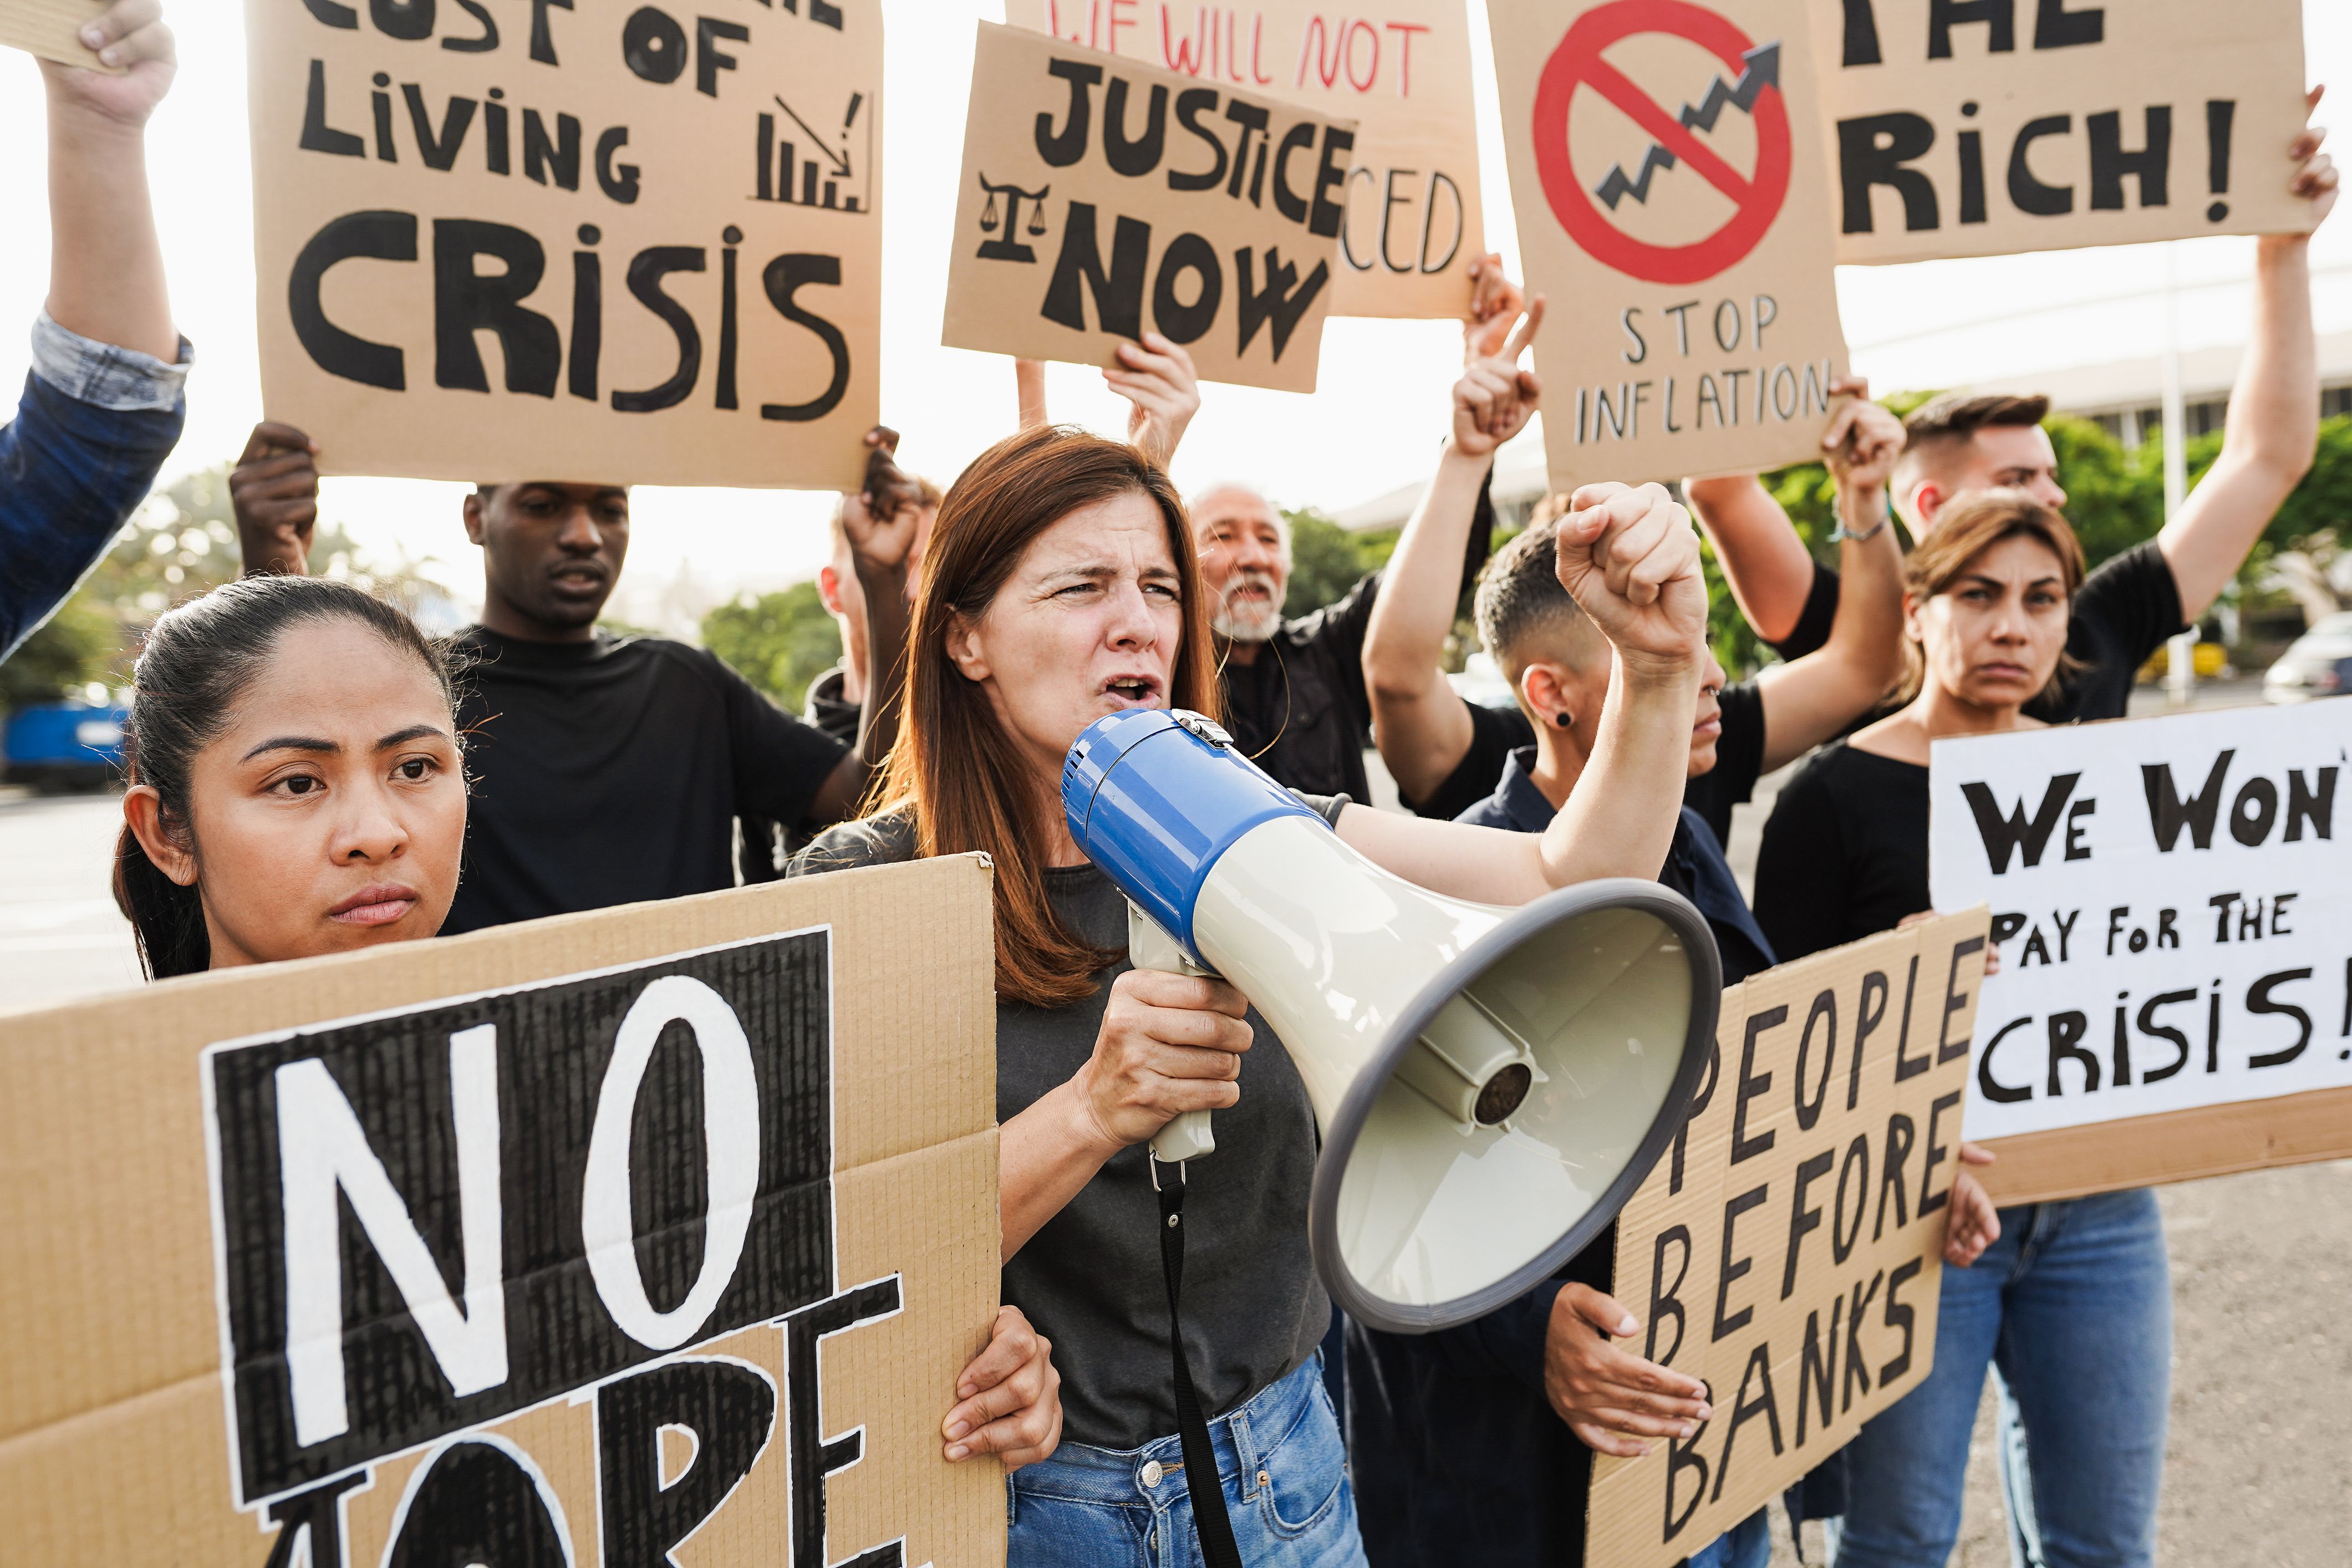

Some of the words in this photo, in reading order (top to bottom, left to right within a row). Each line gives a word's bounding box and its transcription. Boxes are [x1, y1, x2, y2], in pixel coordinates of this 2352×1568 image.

[623, 6, 750, 99] OF
[1161, 4, 1271, 84] WILL
[1295, 14, 1430, 98] NOT
[1337, 166, 1464, 274] CED
[1040, 200, 1328, 364] NOW
[1621, 295, 1778, 364] STOP
[1575, 359, 1831, 444] INFLATION
[2141, 746, 2352, 852] WON'
[1989, 910, 2080, 967] PAY
[2208, 892, 2298, 943] THE
[1669, 935, 1986, 1197] PEOPLE
[276, 974, 760, 1448] NO
[1645, 1090, 1963, 1367] BEFORE
[1664, 1255, 1923, 1544] BANKS
